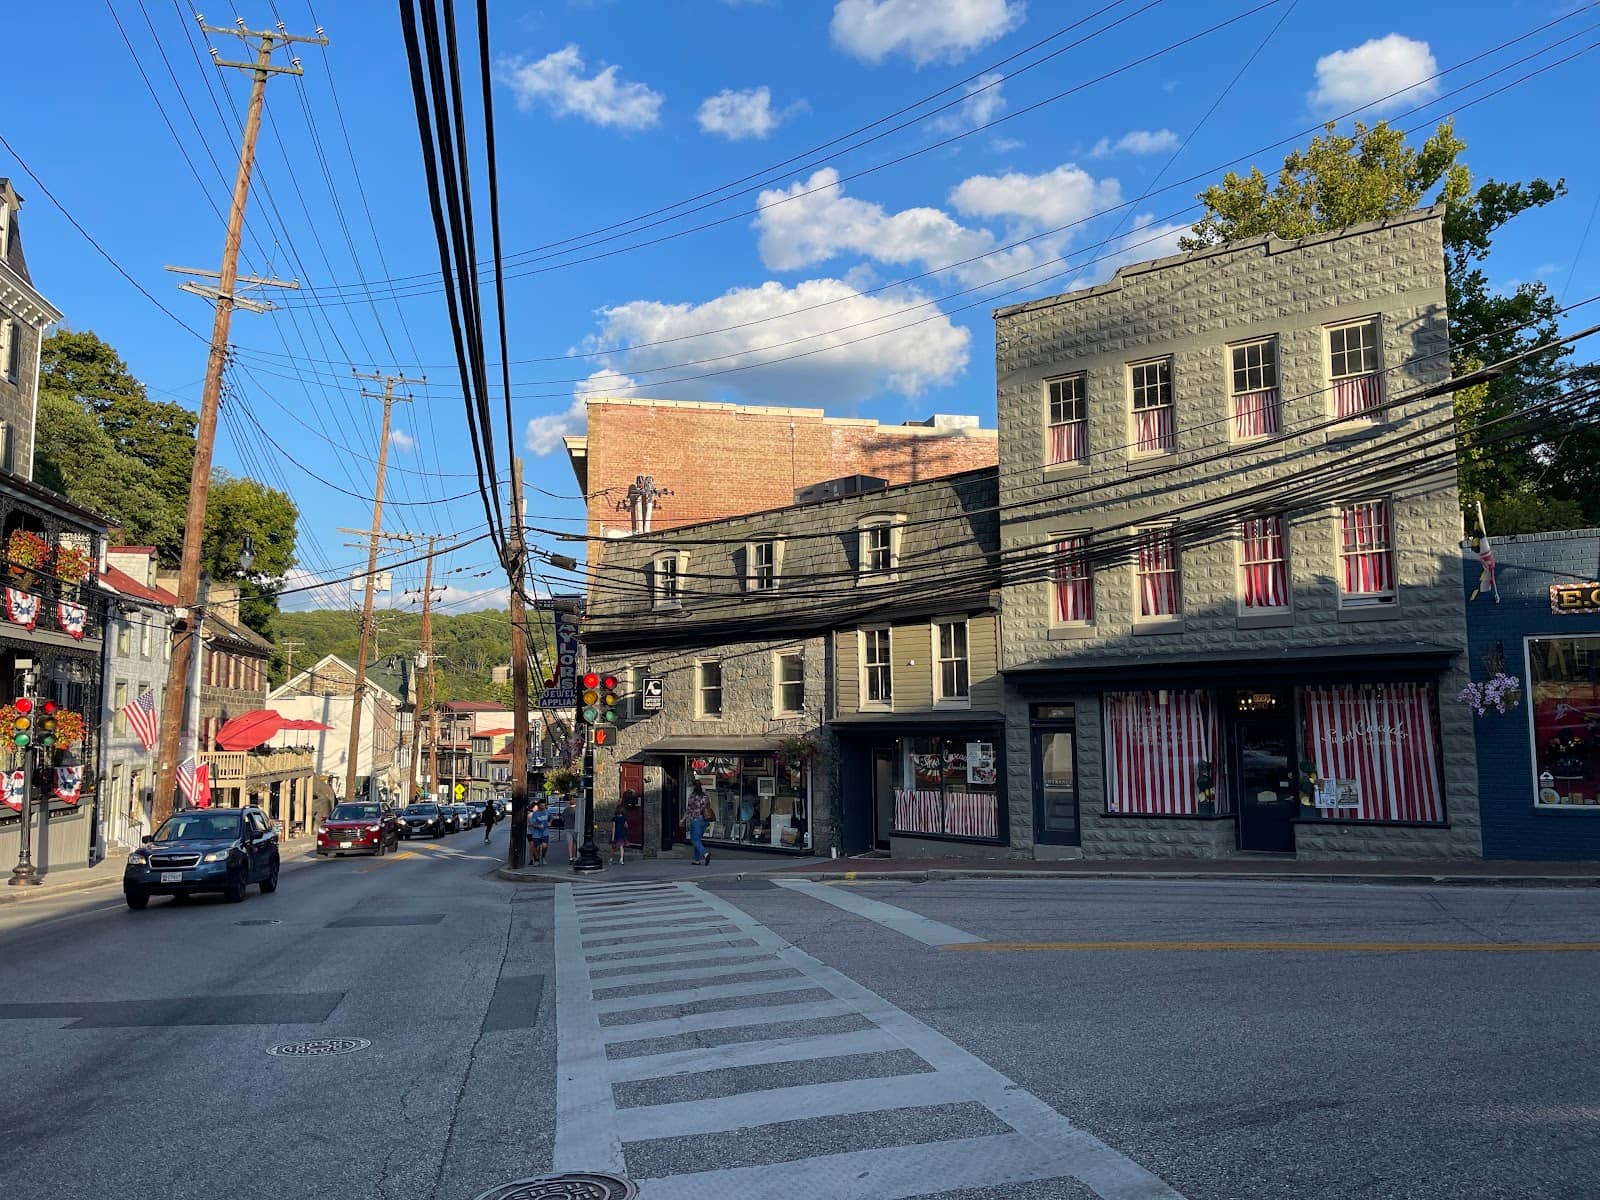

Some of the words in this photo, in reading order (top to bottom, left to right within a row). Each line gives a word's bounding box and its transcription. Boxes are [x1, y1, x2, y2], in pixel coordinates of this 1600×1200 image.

[559, 614, 577, 689] AYLORS
[541, 689, 577, 698] JEWEL
[542, 698, 577, 706] APPLIAN
